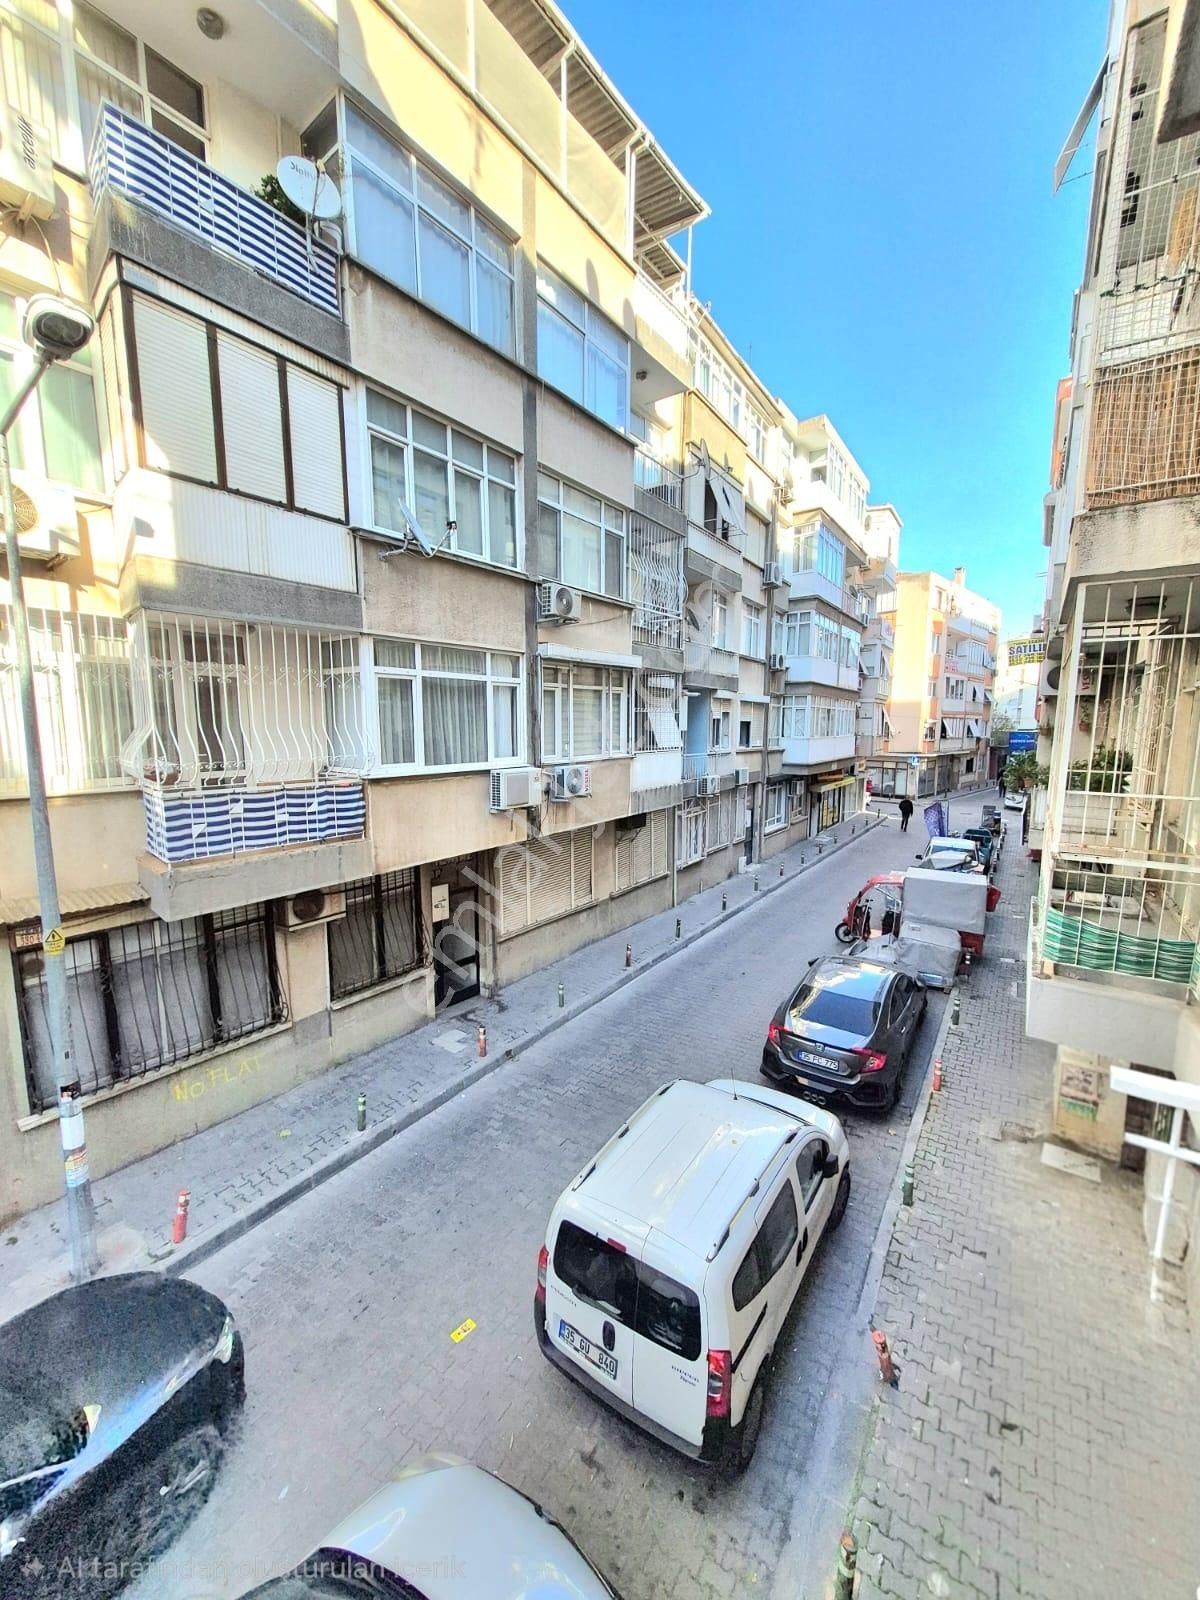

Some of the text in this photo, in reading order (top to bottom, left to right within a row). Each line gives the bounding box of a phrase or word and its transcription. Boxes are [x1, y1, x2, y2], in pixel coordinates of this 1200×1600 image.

[565, 1327, 614, 1372] 35 GU 840
